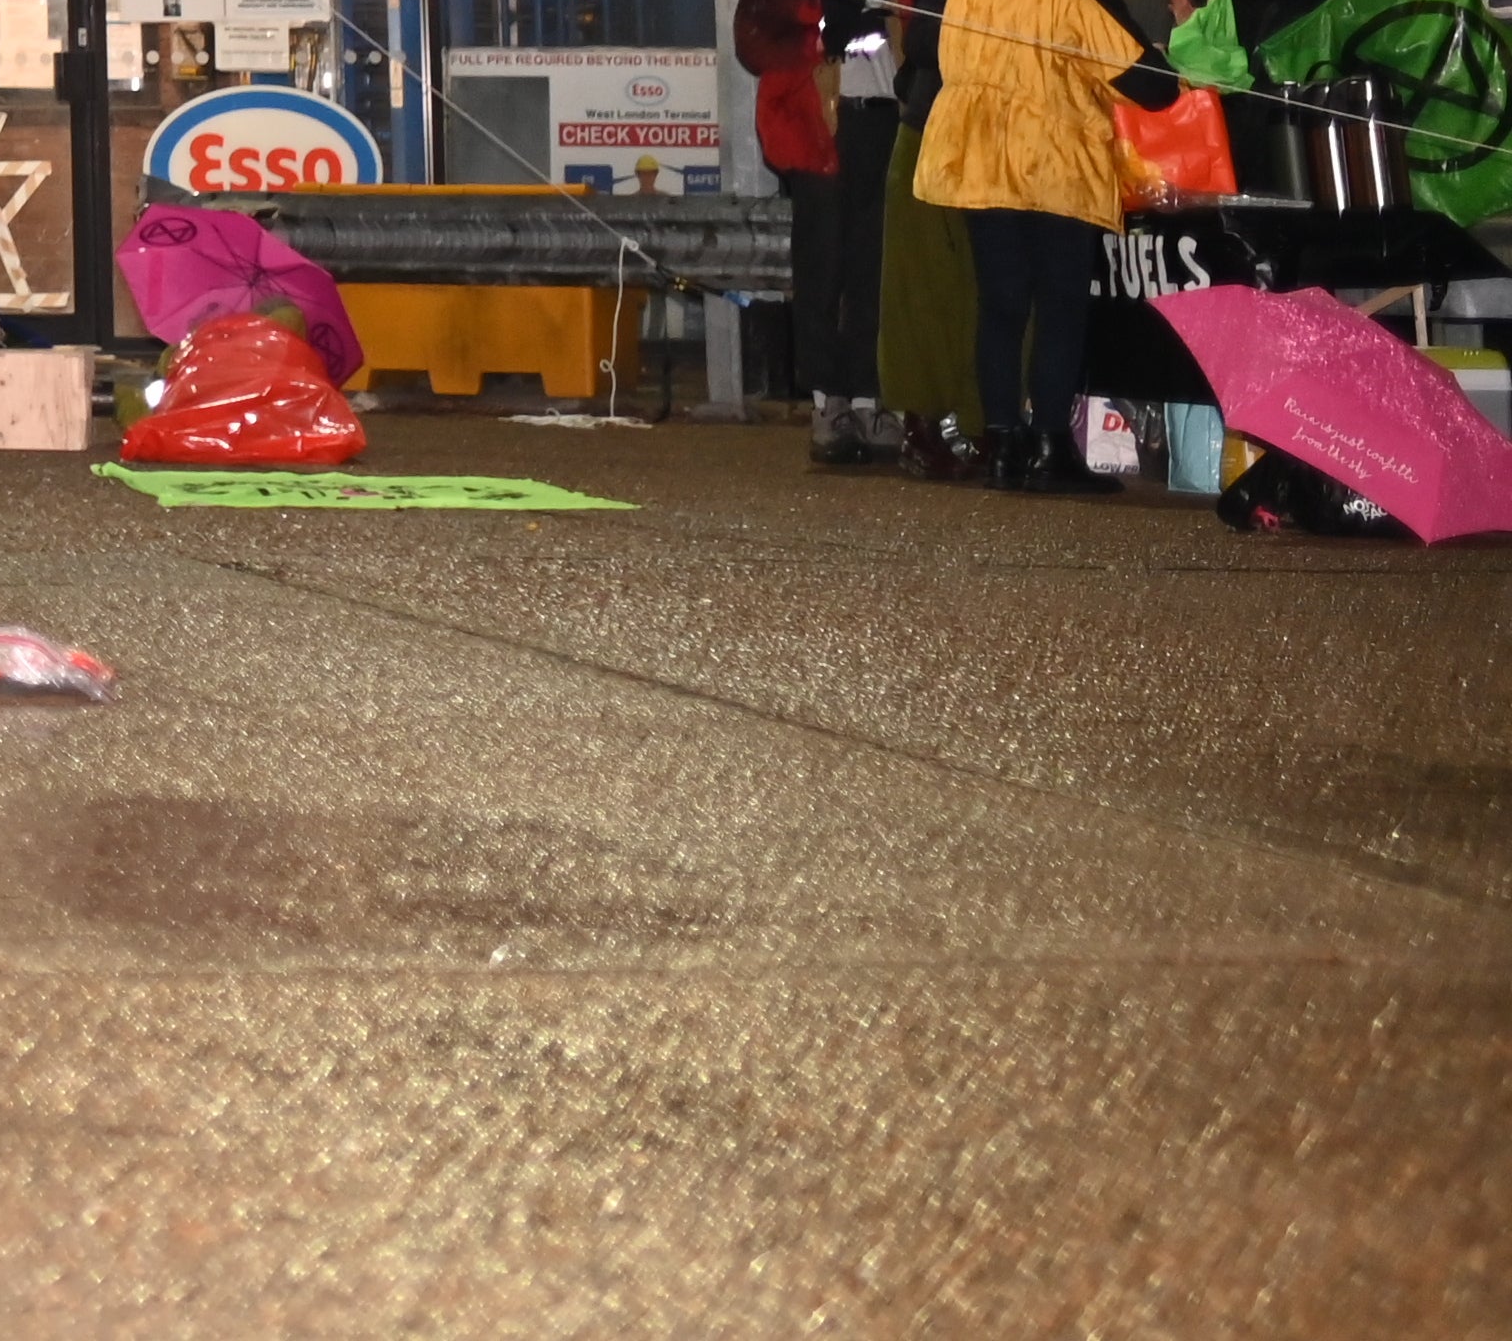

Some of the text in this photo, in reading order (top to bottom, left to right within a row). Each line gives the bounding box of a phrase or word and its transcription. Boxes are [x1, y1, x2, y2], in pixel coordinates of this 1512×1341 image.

[451, 54, 483, 65] FULL
[515, 54, 584, 66] REQUIRED
[586, 55, 643, 66] BEYOND
[646, 55, 672, 67] THE
[674, 55, 702, 67] RED
[705, 55, 718, 67] LI
[632, 83, 664, 97] Esso
[585, 108, 712, 120] West London Terminal
[562, 126, 631, 144] CHECK
[635, 126, 691, 144] YOUR
[189, 133, 343, 193] Esso
[1103, 233, 1211, 299] FUELS
[1292, 426, 1373, 480] from the sky
[1366, 447, 1420, 484] confetti
